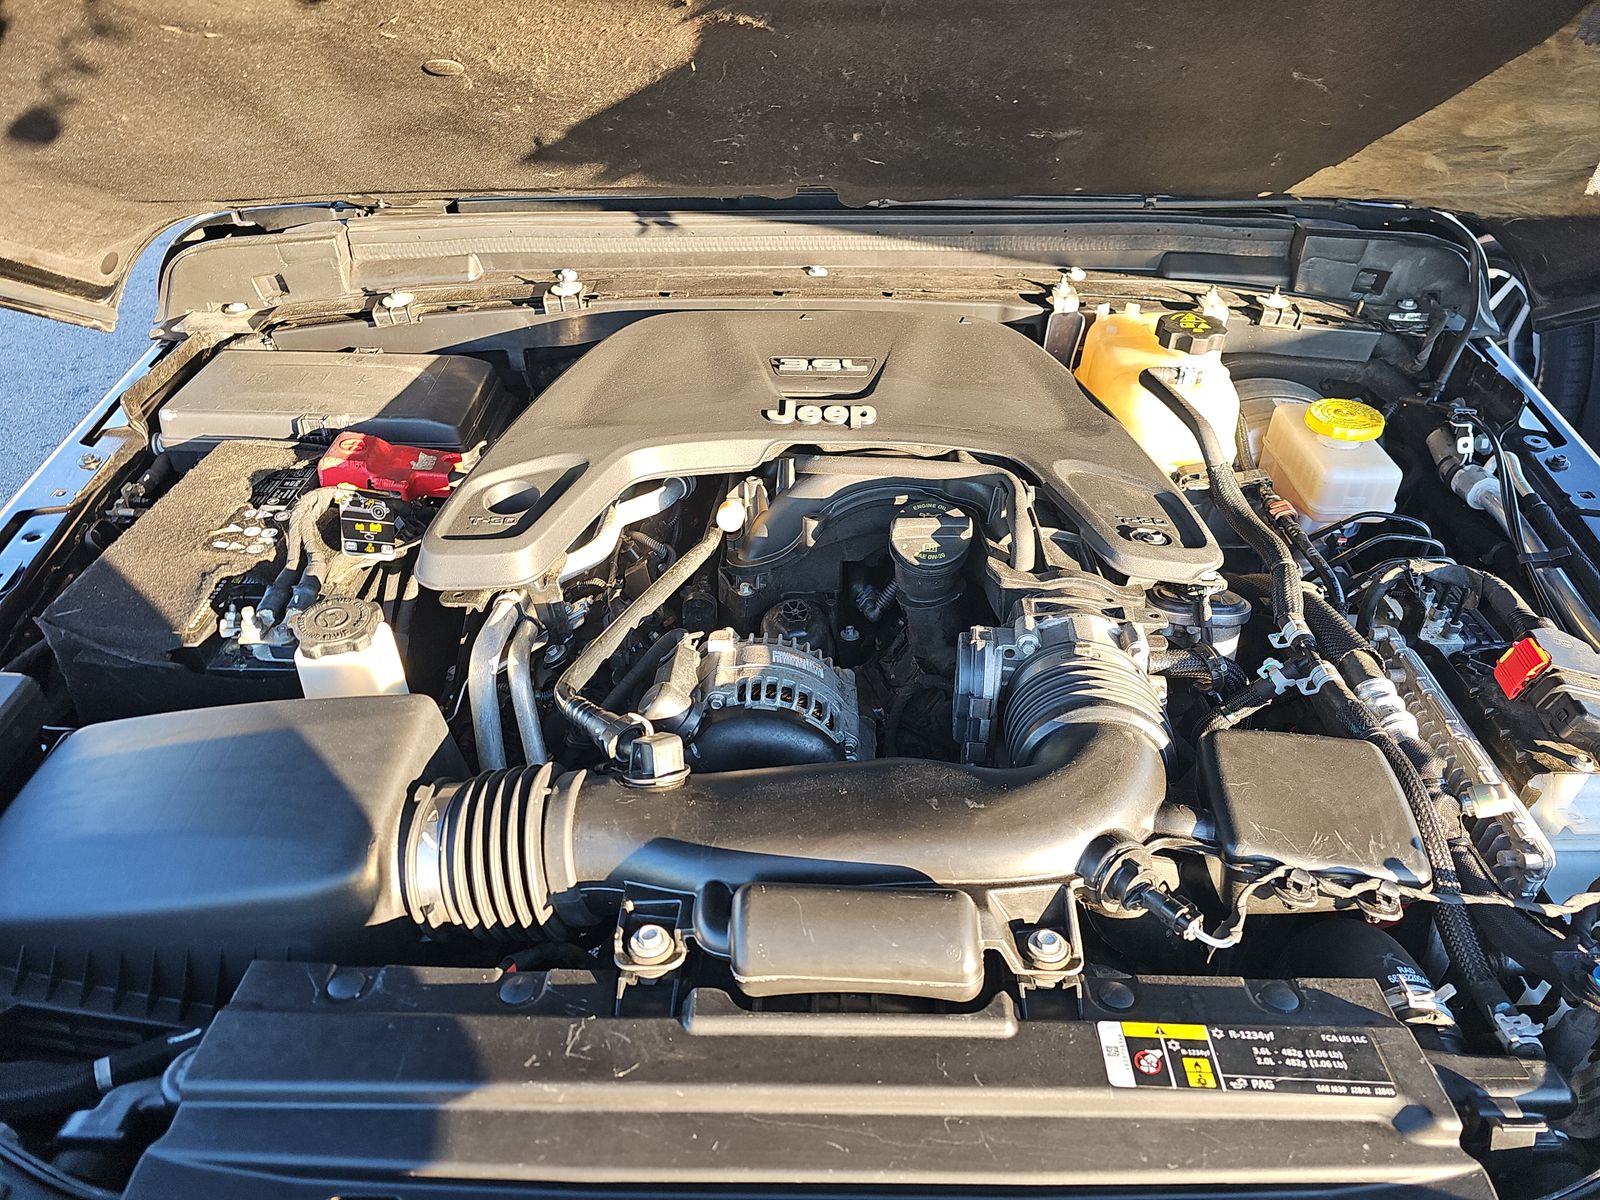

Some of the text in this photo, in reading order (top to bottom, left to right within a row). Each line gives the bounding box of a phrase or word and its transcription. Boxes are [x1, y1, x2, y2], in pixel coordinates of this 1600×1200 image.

[776, 358, 868, 372] 3.6L
[763, 399, 877, 429] Jeep
[912, 503, 936, 511] ENGINE
[927, 552, 946, 560] 0W-20
[1396, 966, 1416, 975] RAD
[1228, 1030, 1274, 1042] R-1234yf
[1321, 1034, 1369, 1044] FCA US LLC
[1252, 1046, 1272, 1056] 3.6L
[1281, 1048, 1304, 1059] 482g
[1305, 1049, 1328, 1059] (1.06
[1255, 1056, 1276, 1066] 2.0L
[1285, 1058, 1308, 1068] 482g
[1309, 1059, 1333, 1069] (1.06
[1250, 1079, 1275, 1090] PAG
